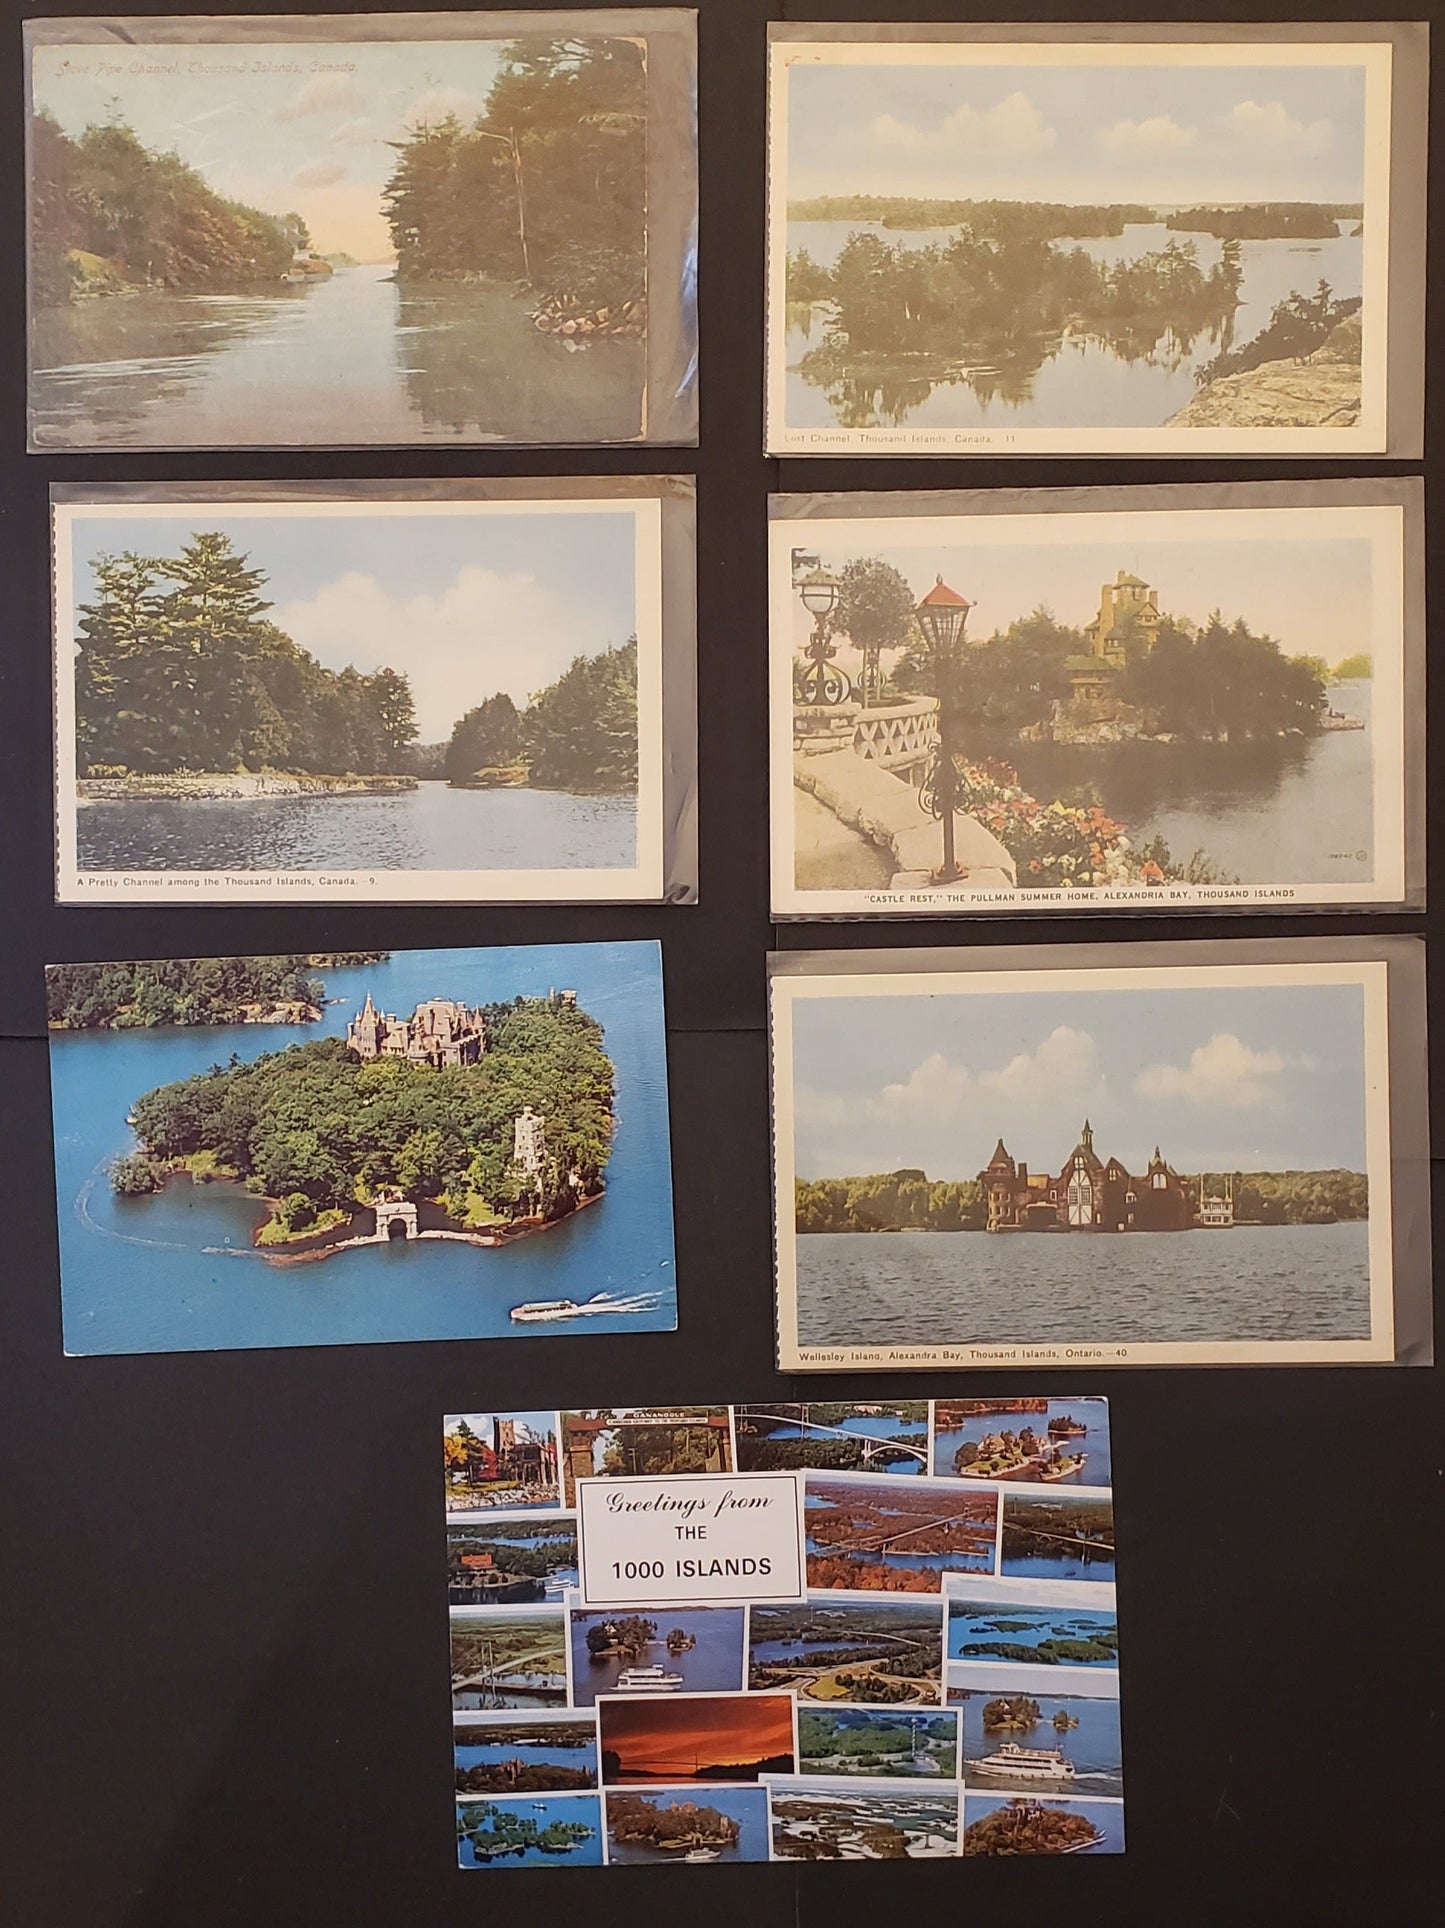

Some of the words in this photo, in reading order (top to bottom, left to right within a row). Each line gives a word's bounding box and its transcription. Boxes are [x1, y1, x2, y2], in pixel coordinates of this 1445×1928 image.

[95, 62, 122, 76] Pipe
[187, 60, 248, 74] Thousand
[309, 60, 359, 73] Canada.
[860, 433, 906, 443] Thousand
[77, 878, 84, 886] A
[88, 877, 118, 887] Pretty
[123, 877, 163, 886] Channel
[167, 879, 200, 887] among
[204, 877, 220, 886] the
[224, 876, 272, 886] Thousand
[276, 876, 315, 887] Islands,
[947, 894, 966, 903] THE
[970, 893, 1015, 902] PULLMAN
[1020, 893, 1062, 901] SUMMER
[1103, 891, 1164, 901] ALEXANDRIA
[1196, 890, 1250, 900] THOUSAND
[1254, 889, 1296, 899] ISLANDS
[798, 1351, 845, 1362] Wellesley
[850, 1351, 883, 1362] Island,
[888, 1351, 938, 1360] Alexandra
[942, 1351, 964, 1361] Bay,
[969, 1350, 1017, 1360] Thousand
[1021, 1349, 1060, 1360] Islands,
[606, 1491, 710, 1518] Greetings
[713, 1489, 774, 1518] from
[674, 1525, 708, 1540] THE
[611, 1561, 665, 1580] 1000
[675, 1557, 772, 1578] ISLANDS
